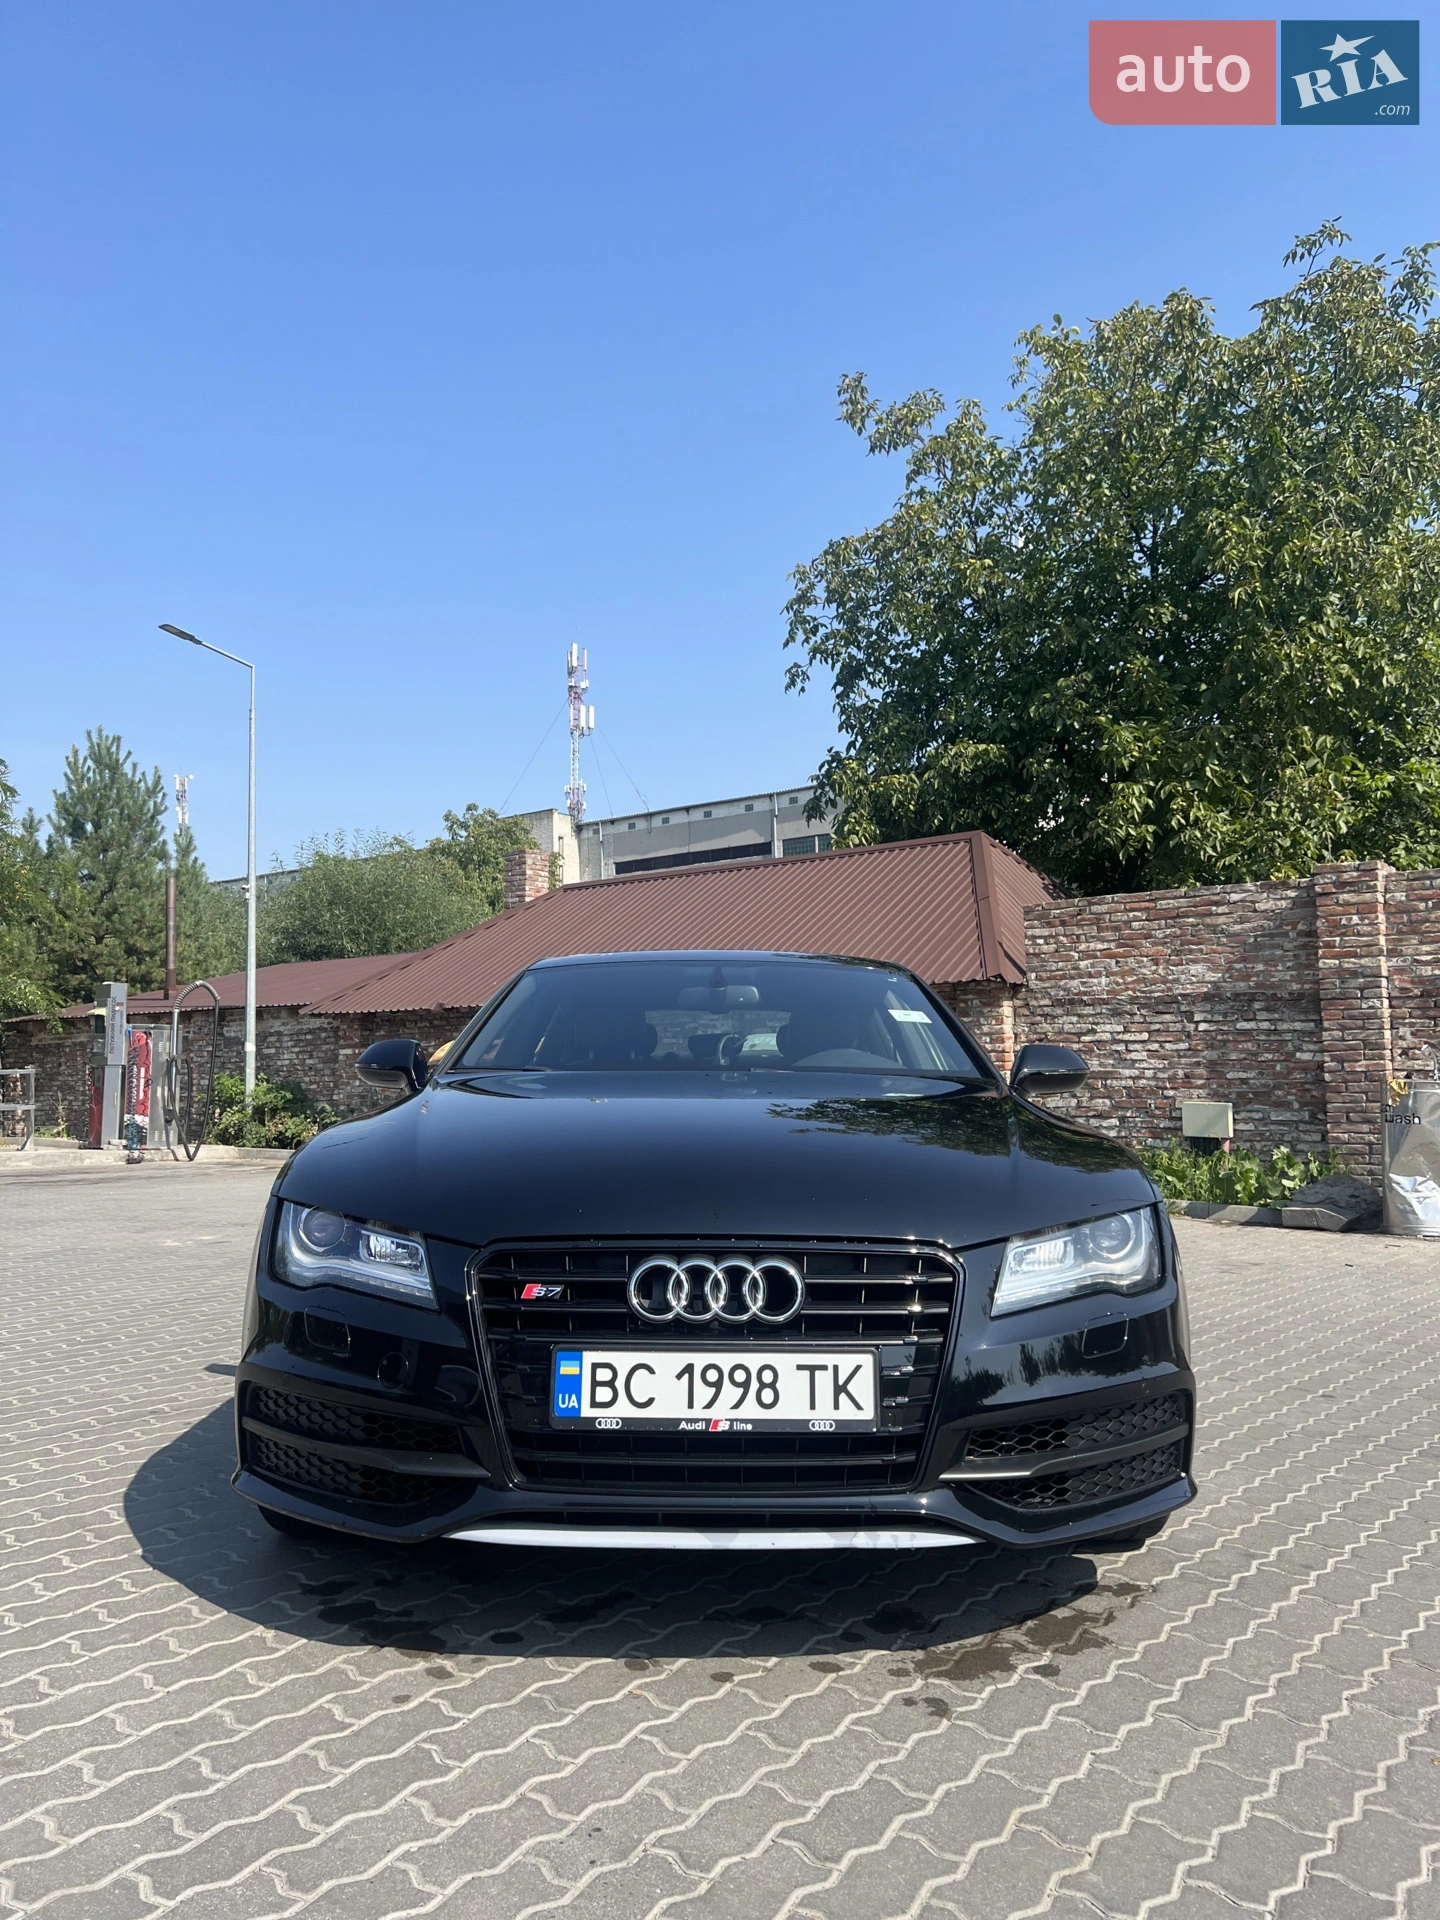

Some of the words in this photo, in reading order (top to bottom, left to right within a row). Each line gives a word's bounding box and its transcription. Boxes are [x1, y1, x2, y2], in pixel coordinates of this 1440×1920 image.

[531, 1287, 562, 1297] S7
[589, 1362, 656, 1410] BC
[675, 1362, 780, 1411] 1998
[796, 1364, 865, 1411] TK
[558, 1394, 579, 1409] UA
[678, 1420, 706, 1430] Audi
[733, 1421, 753, 1431] line
